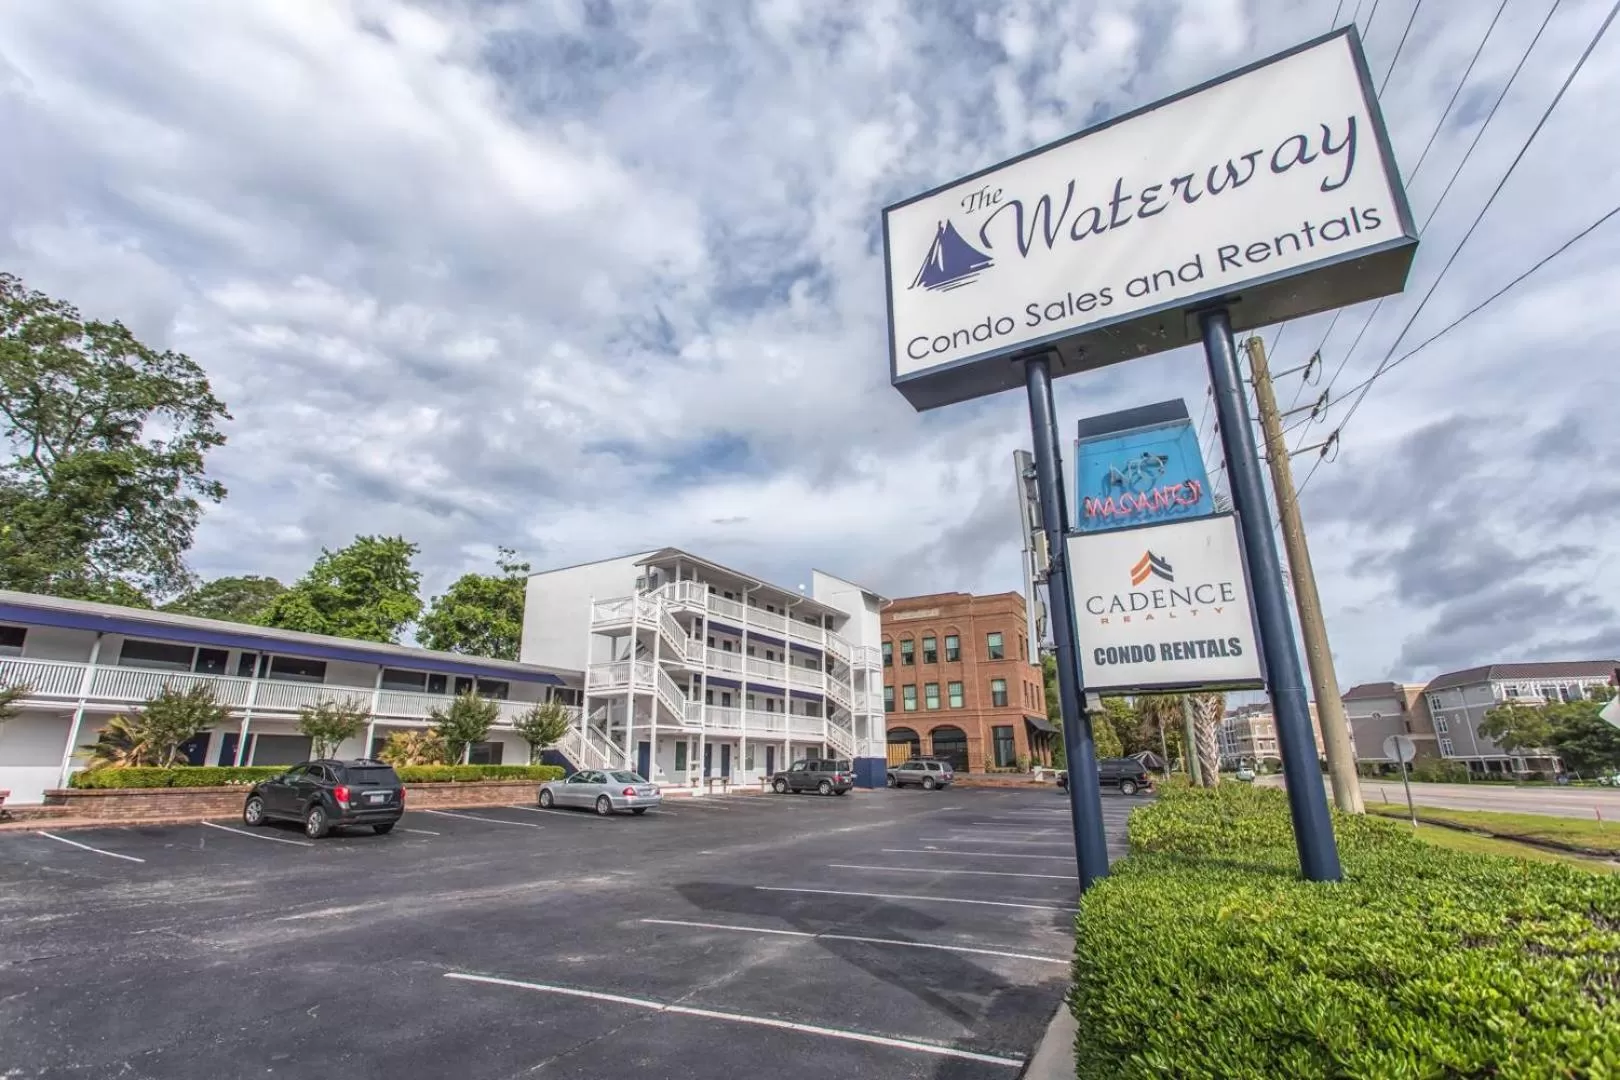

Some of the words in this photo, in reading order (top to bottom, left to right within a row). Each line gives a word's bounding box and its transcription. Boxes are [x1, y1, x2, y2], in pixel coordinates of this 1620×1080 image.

[961, 186, 1004, 214] The
[981, 116, 1357, 258] Waterway
[907, 317, 1015, 360] Condo
[1026, 287, 1113, 328] Sales
[1125, 254, 1204, 297] and
[1218, 206, 1382, 272] Rentals
[1086, 583, 1236, 615] CADENCE
[1101, 607, 1224, 624] REALTY
[1094, 645, 1157, 666] CONDO
[1161, 637, 1243, 661] RENTALS
